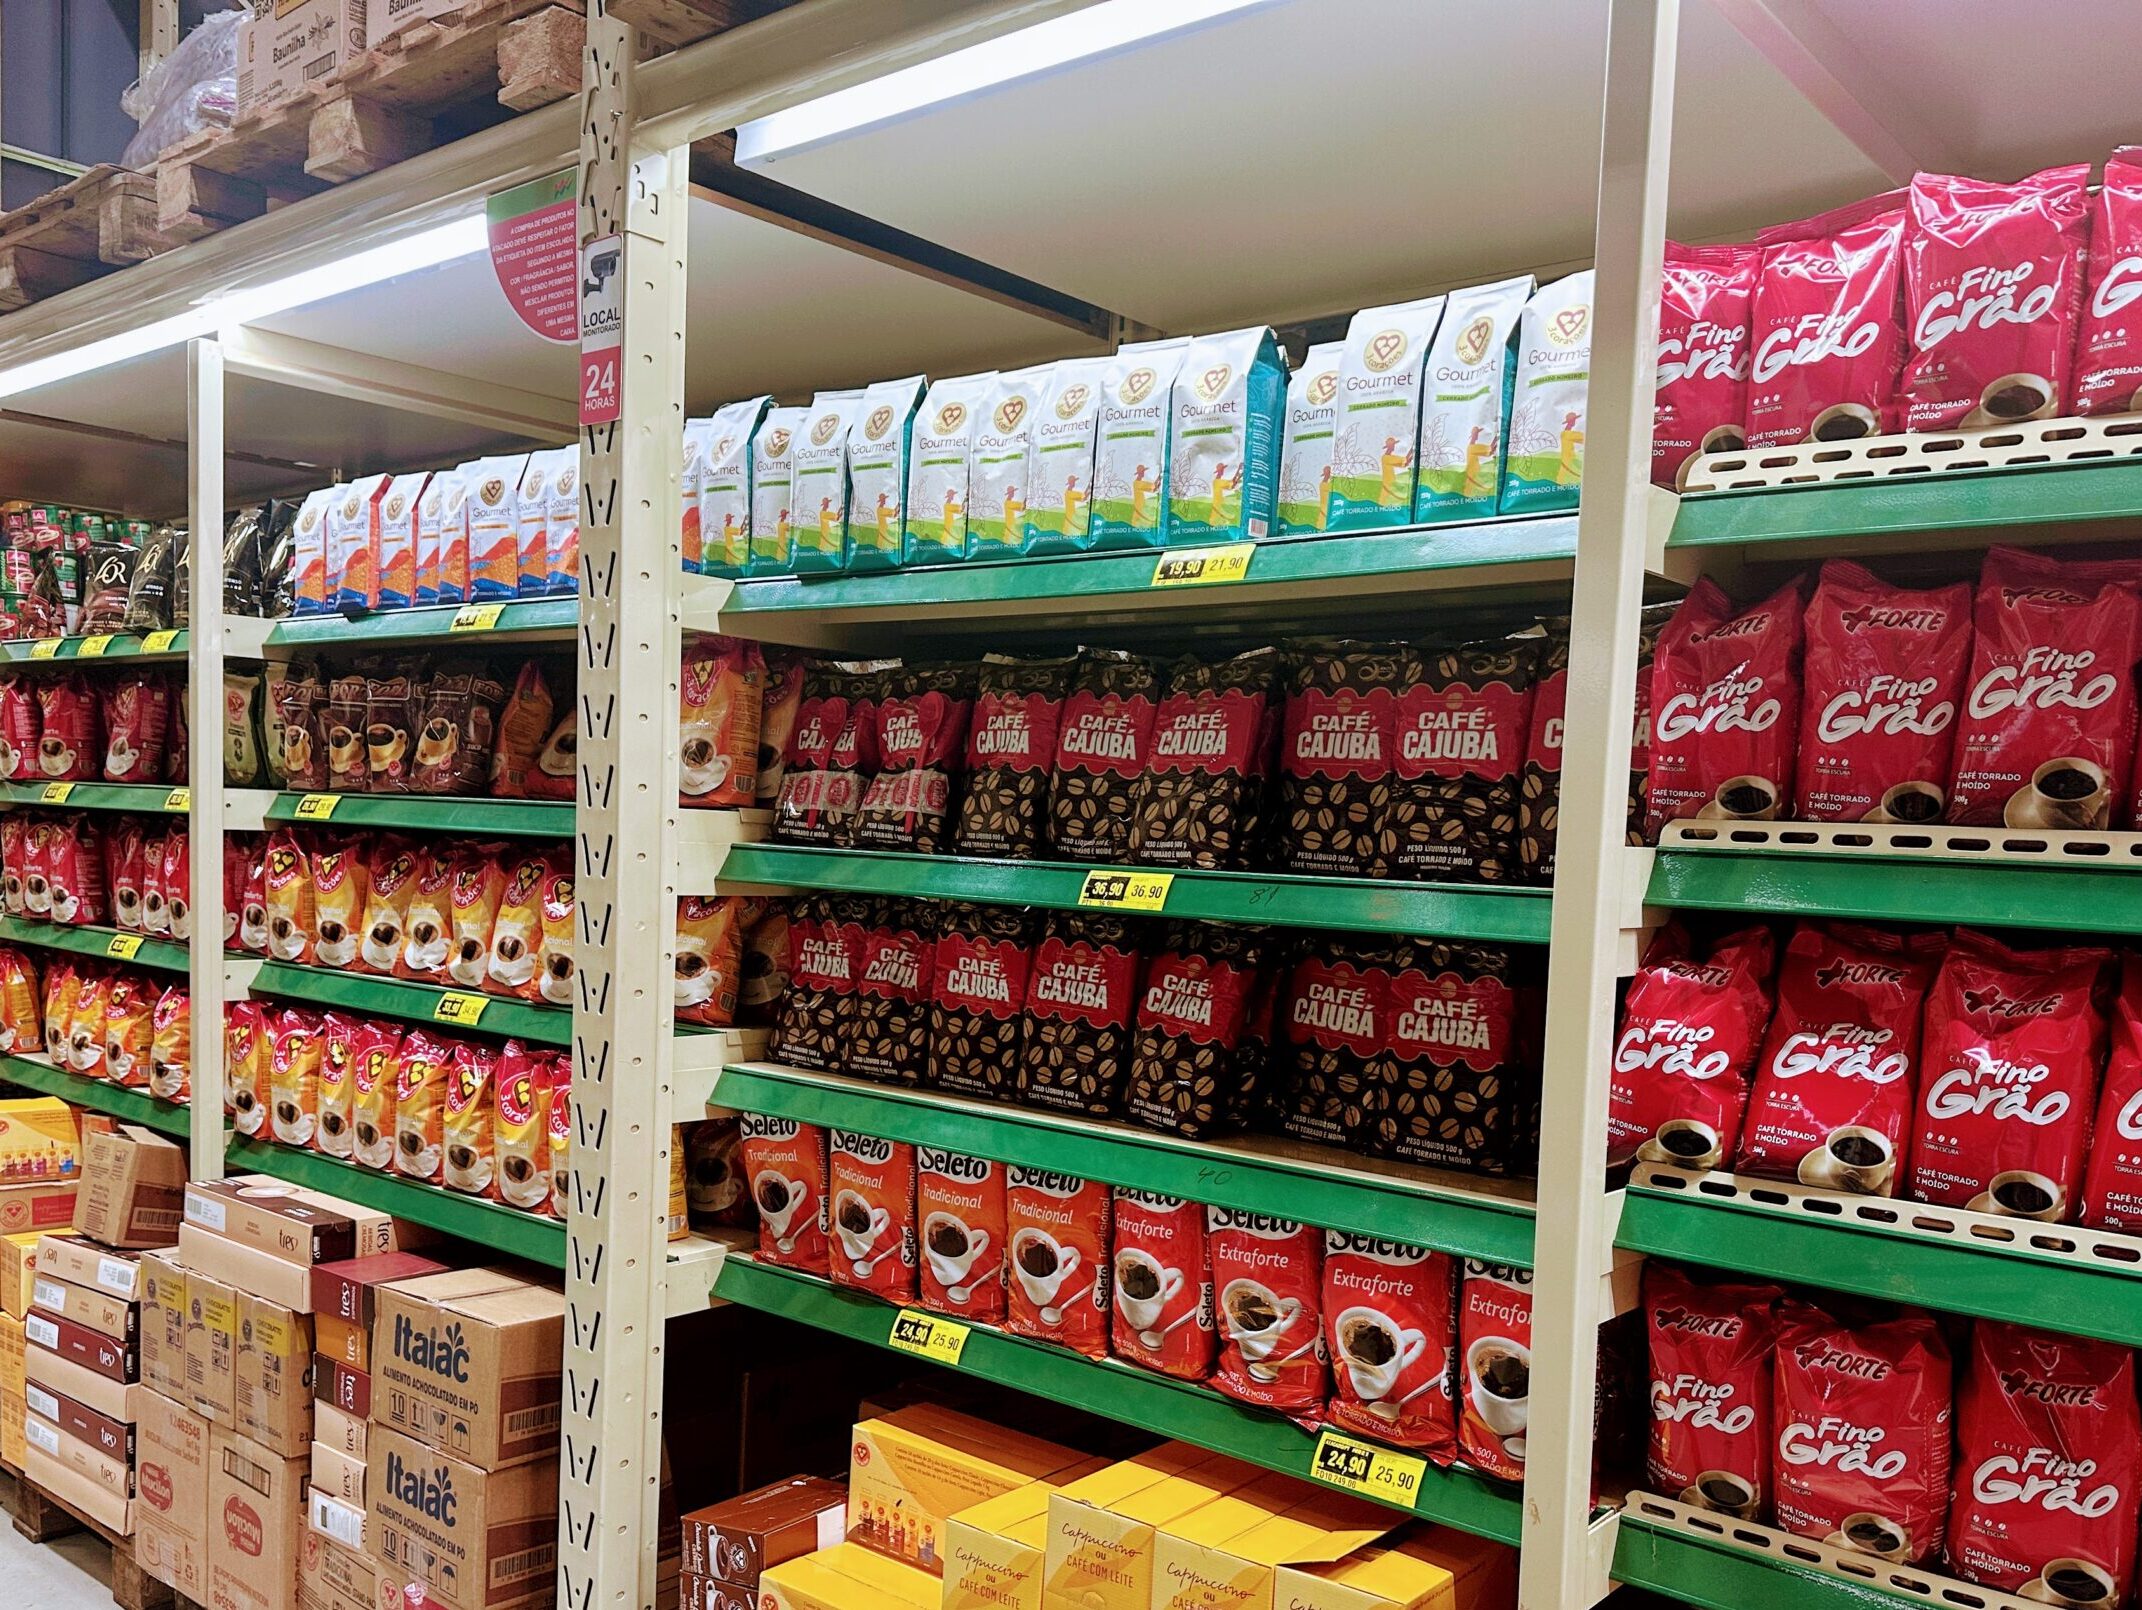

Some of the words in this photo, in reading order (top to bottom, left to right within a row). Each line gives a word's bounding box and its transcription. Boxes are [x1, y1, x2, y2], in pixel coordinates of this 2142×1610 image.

[273, 34, 306, 64] Baunilha
[1930, 276, 1956, 290] CAFÉ
[1957, 261, 2034, 300] Fino
[583, 307, 620, 328] LOCAL
[583, 322, 620, 337] MONITORADO
[1770, 315, 1796, 326] CAFÉ
[1914, 284, 2056, 352] Grão
[1685, 322, 1746, 350] Fino
[586, 360, 615, 399] 24
[1346, 371, 1414, 391] Gourmet
[585, 395, 615, 411] HORAS
[1105, 406, 1161, 422] Gourmet
[1180, 400, 1237, 418] Gourmet
[1910, 401, 1929, 412] CAFÉ
[1040, 419, 1090, 437] Gourmet
[797, 446, 841, 461] Gourmet
[851, 440, 897, 455] Gourmet
[919, 436, 968, 451] Gourmet
[472, 506, 512, 518] Gourmet
[1169, 561, 1201, 576] 19,90
[1210, 557, 1243, 572] 21,90
[2020, 646, 2095, 678] Fino
[1701, 676, 1764, 705] Fino
[1866, 675, 1937, 703] Fino
[1968, 665, 2117, 720] Grão
[987, 710, 1027, 730] CAFÉ
[1080, 709, 1129, 733] CAFÉ
[1174, 709, 1222, 730] CAFÉ
[1312, 711, 1371, 732] CAFÉ
[1418, 707, 1486, 730] CAFÉ
[1656, 698, 1781, 742] Grão
[1818, 691, 1954, 743] Grão
[976, 725, 1031, 755] CAJUBÁ
[1063, 727, 1136, 760] CAJUBÁ
[1157, 723, 1228, 755] CAJUBÁ
[1296, 726, 1381, 760] CAJUBÁ
[1403, 723, 1498, 760] CAJUBÁ
[1958, 771, 1976, 780] CAFÉ
[1978, 772, 2021, 781] TORRADO
[1652, 789, 1668, 798] CAFÉ
[1809, 791, 1827, 800] CAFÉ
[1417, 855, 1446, 864] TORRADO
[1092, 882, 1124, 899] 36,90
[803, 938, 844, 955] CAFÉ
[959, 957, 1000, 978] CAFÉ
[1052, 962, 1102, 983] CAFÉ
[947, 970, 1010, 1002] CAJUBÁ
[1037, 975, 1108, 1009] CAJUBÁ
[1163, 974, 1210, 994] CAFÉ
[1309, 983, 1367, 1008] CAFÉ
[1146, 987, 1213, 1025] CAJUBÁ
[1293, 999, 1375, 1038] CAJUBÁ
[1414, 998, 1477, 1019] CAFÉ
[1398, 1013, 1491, 1050] CAJUBÁ
[1648, 1019, 1715, 1043] Fino
[1821, 1022, 1893, 1045] Fino
[1614, 1027, 1730, 1080] Grão
[1772, 1032, 1909, 1084] Grão
[1949, 1055, 1975, 1067] CAFÉ
[1974, 1057, 2048, 1085] Fino
[1926, 1068, 2070, 1126] Grão
[742, 1112, 797, 1137] Seleto
[1757, 1124, 1775, 1135] CAFÉ
[1777, 1127, 1817, 1142] TORRADO
[747, 1149, 798, 1162] Tradicional
[833, 1130, 889, 1161] Seleto
[834, 1161, 883, 1189] Tradicional
[920, 1147, 988, 1180] Seleto
[1917, 1167, 1936, 1179] CAFÉ
[1937, 1172, 1979, 1187] TORRADO
[1922, 1178, 1950, 1190] MOÍDO
[905, 1164, 916, 1222] Tradicional
[923, 1183, 982, 1210] Tradicional
[2107, 1191, 2131, 1202] CAFÉ
[1012, 1199, 1074, 1225] Tradicional
[377, 1221, 392, 1254] tres
[1116, 1212, 1173, 1239] Extraforte
[279, 1229, 295, 1251] tres
[903, 1228, 915, 1265] Seleto
[1219, 1243, 1289, 1270] Extraforte
[1095, 1266, 1109, 1309] Seleto
[1333, 1268, 1413, 1297] Extraforte
[341, 1282, 350, 1317] tres
[1200, 1283, 1213, 1327] Seleto
[394, 1313, 470, 1383] Italac
[901, 1323, 928, 1342] 24,90
[933, 1333, 960, 1351] 25,90
[346, 1374, 356, 1409] tres
[383, 1365, 411, 1386] ALIMENTO
[412, 1380, 458, 1406] ACHOCOLATADO
[459, 1398, 468, 1410] EM
[469, 1400, 478, 1415] PÓ
[1673, 1374, 1735, 1398] Fino
[391, 1392, 405, 1415] 10
[1650, 1380, 1754, 1433] Grão
[1817, 1417, 1885, 1442] Fino
[1477, 1446, 1489, 1459] 500
[1779, 1423, 1907, 1479] Grão
[1994, 1440, 2022, 1454] CAFÉ
[1327, 1450, 1367, 1475] 24,90
[1376, 1465, 1415, 1490] 25,90
[2022, 1448, 2097, 1478] Fino
[141, 1471, 171, 1497] Mucilon
[387, 1451, 457, 1527] Italac
[1972, 1455, 2119, 1518] Grão
[1778, 1501, 1795, 1514] CAFÉ
[376, 1502, 402, 1525] ALIMENTO
[403, 1517, 447, 1549] ACHOCOLATADO
[447, 1541, 456, 1553] EM
[457, 1545, 465, 1560] PÓ
[384, 1529, 396, 1551] 10
[1062, 1522, 1143, 1558] Cappuccino
[955, 1547, 1029, 1580] Cappuccino
[1095, 1550, 1106, 1560] ou
[1966, 1547, 1986, 1560] CAFÉ
[1987, 1553, 2031, 1573] TORRADO
[1971, 1560, 2001, 1574] MOÍDO
[986, 1574, 995, 1584] ou
[1066, 1554, 1088, 1572] CAFÉ
[1090, 1563, 1108, 1577] COM
[1111, 1571, 1133, 1588] LEITE
[1167, 1562, 1255, 1599] Cappuccino
[960, 1577, 979, 1594] CAFÉ
[980, 1587, 997, 1600] COM
[1000, 1594, 1020, 1610] LEITE
[1203, 1591, 1215, 1602] ou
